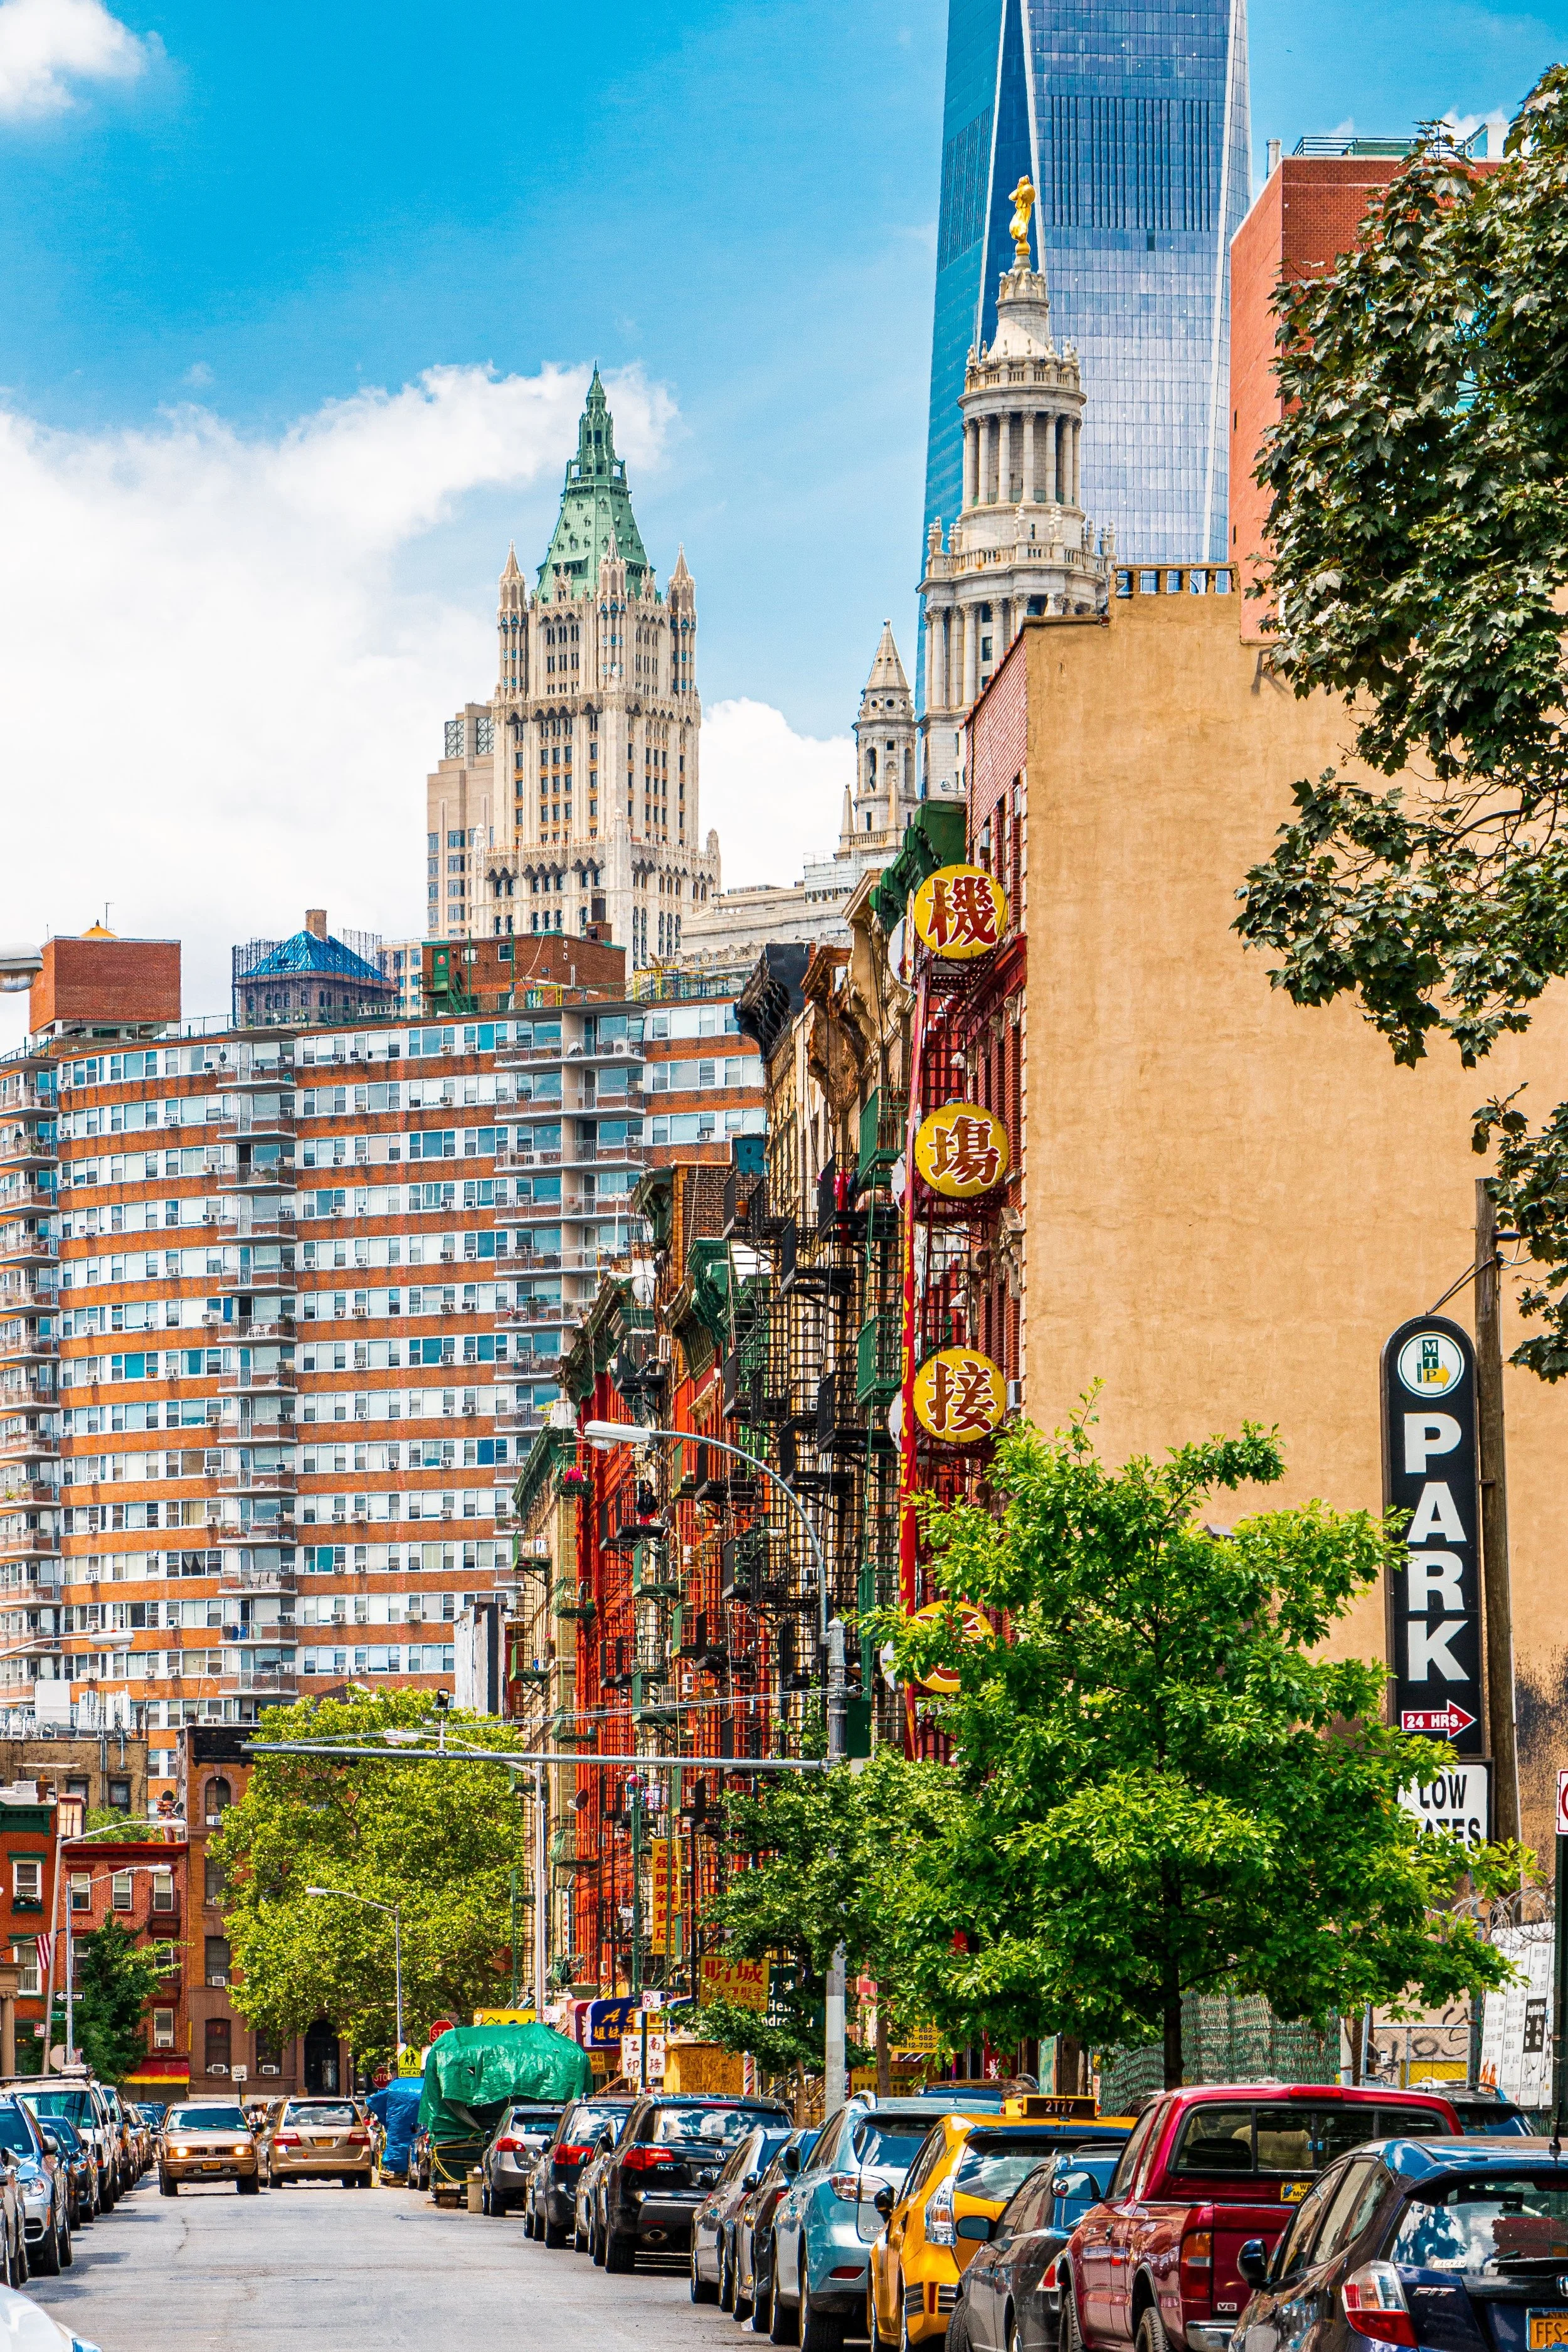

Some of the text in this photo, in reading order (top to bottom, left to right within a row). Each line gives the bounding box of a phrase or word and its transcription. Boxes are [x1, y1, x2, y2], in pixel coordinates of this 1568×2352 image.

[1404, 1413, 1470, 1682] PARK
[1407, 1714, 1463, 1728] 24 HRS.
[704, 1960, 764, 1985] 明城
[1046, 2100, 1074, 2112] 2T77
[1412, 2287, 1456, 2296] FIT
